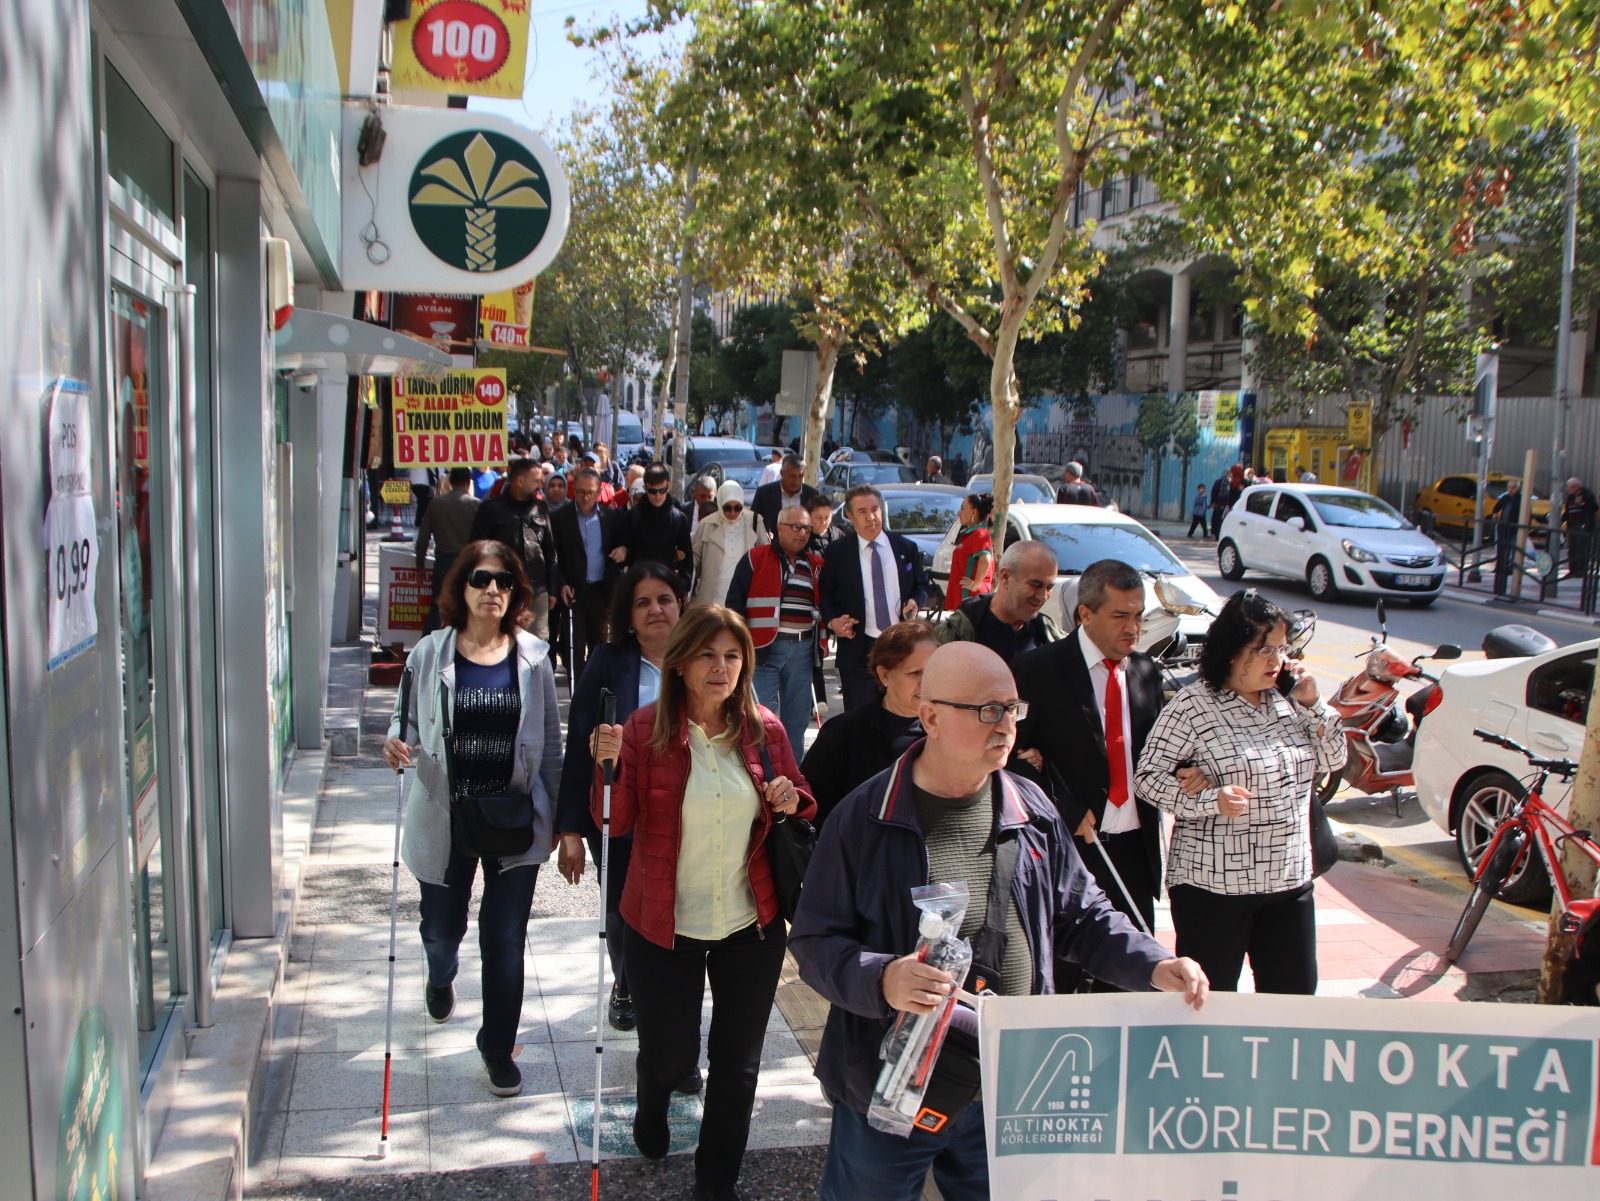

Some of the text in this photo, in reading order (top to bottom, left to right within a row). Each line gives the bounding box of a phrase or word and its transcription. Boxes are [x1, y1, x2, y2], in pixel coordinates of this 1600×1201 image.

[427, 19, 497, 62] 100
[416, 304, 452, 314] AYRAN
[494, 325, 516, 343] 140
[479, 383, 501, 397] 140
[424, 397, 458, 410] ALANA
[397, 409, 503, 432] 1 TAVUK DÜRÜM
[62, 422, 77, 448] POS
[397, 433, 505, 463] BEDAVA
[57, 538, 89, 609] 0,99
[1149, 1035, 1571, 1094] ALTINOKTA
[1047, 1101, 1065, 1110] 1950
[1002, 1118, 1103, 1134] ALTINOKTA
[1149, 1096, 1568, 1162] KÖRLER DERNEĞİ
